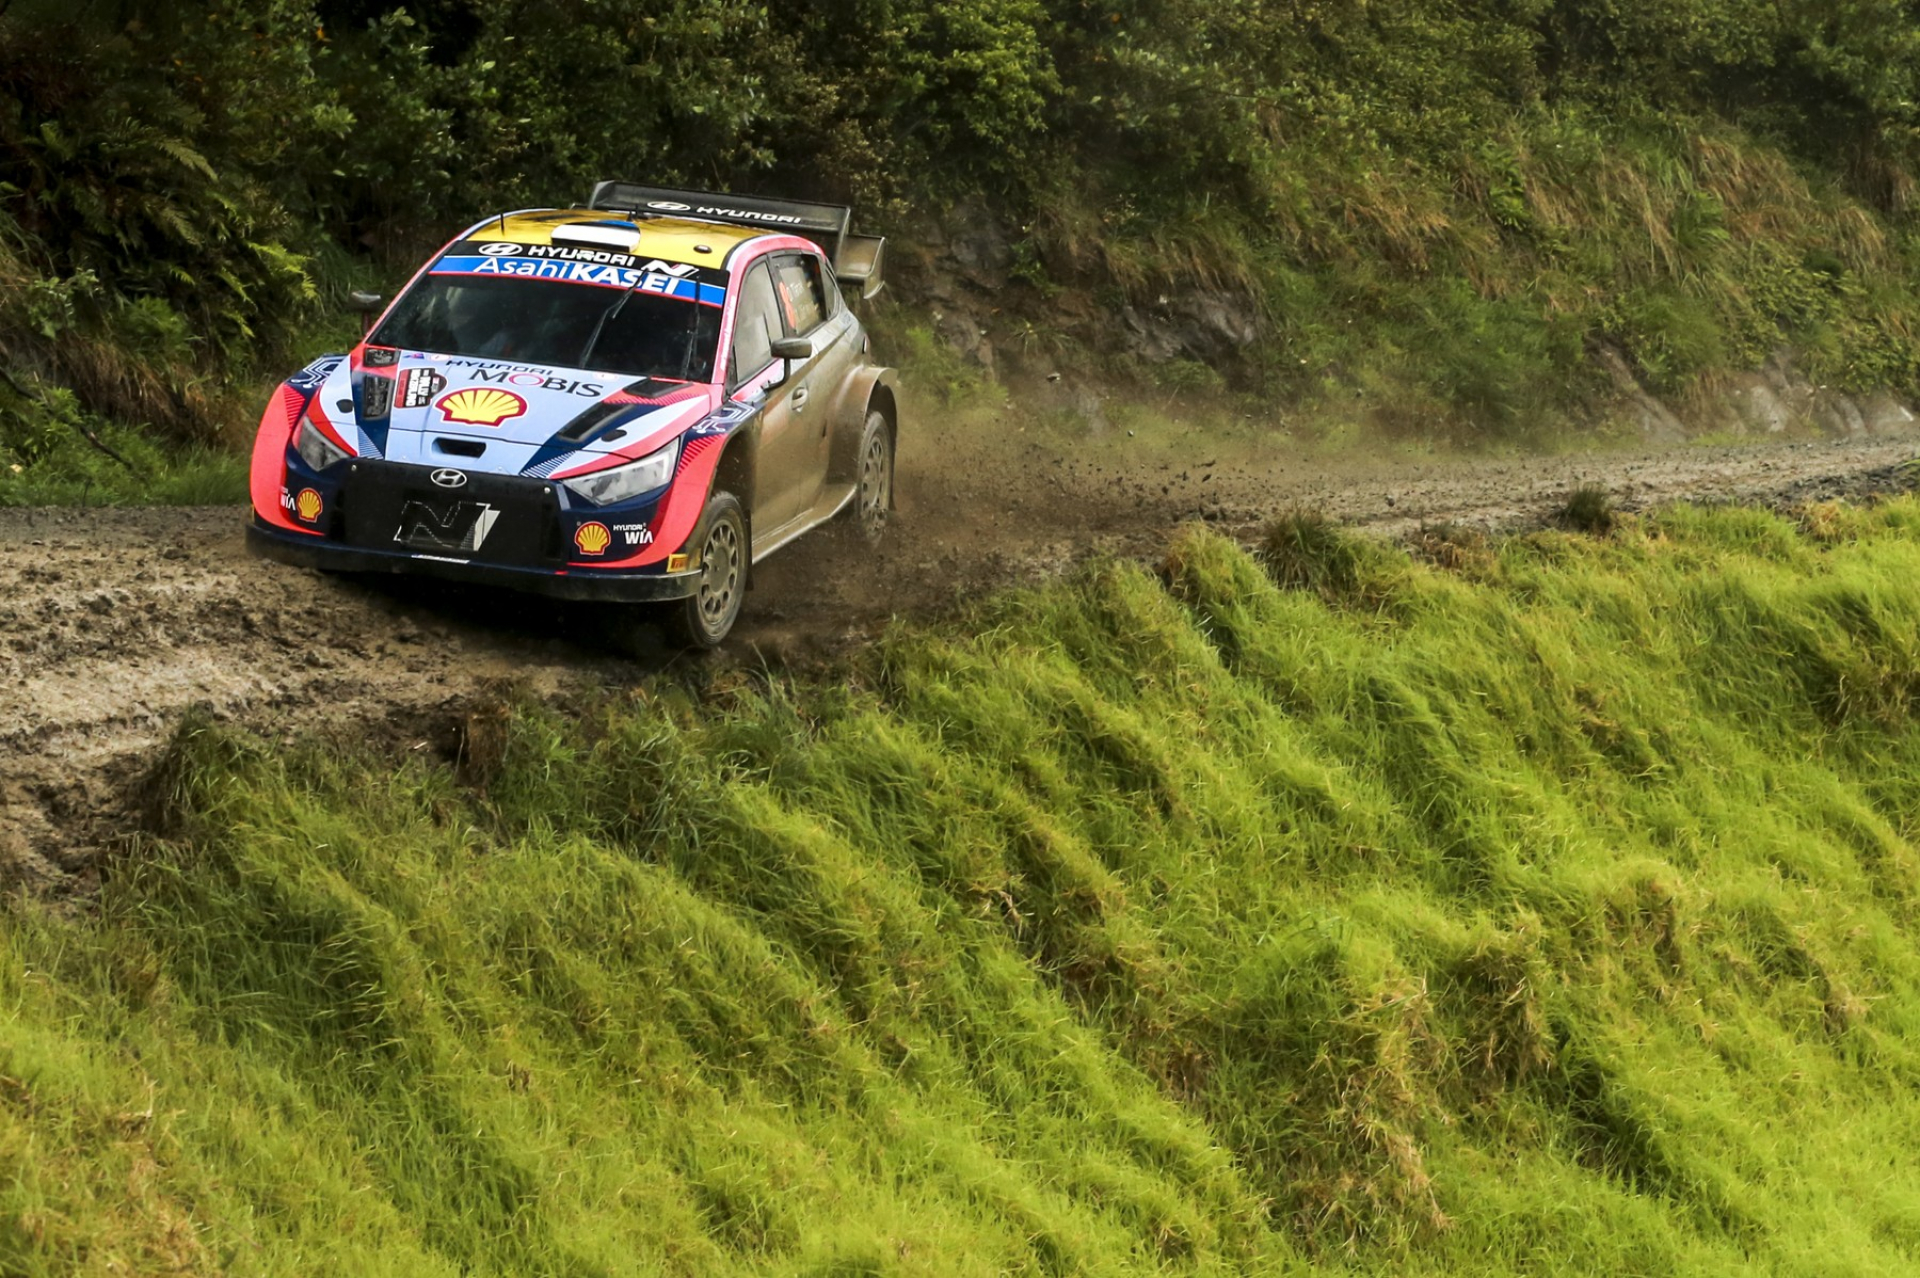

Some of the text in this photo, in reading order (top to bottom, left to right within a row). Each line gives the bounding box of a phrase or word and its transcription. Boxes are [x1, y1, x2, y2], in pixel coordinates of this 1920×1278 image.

[697, 206, 801, 224] HYUNDAI
[528, 245, 636, 267] HYUNDAI
[473, 256, 681, 295] AsahiKASEI
[446, 360, 554, 375] HYUNDAI
[469, 369, 604, 398] MOBIS
